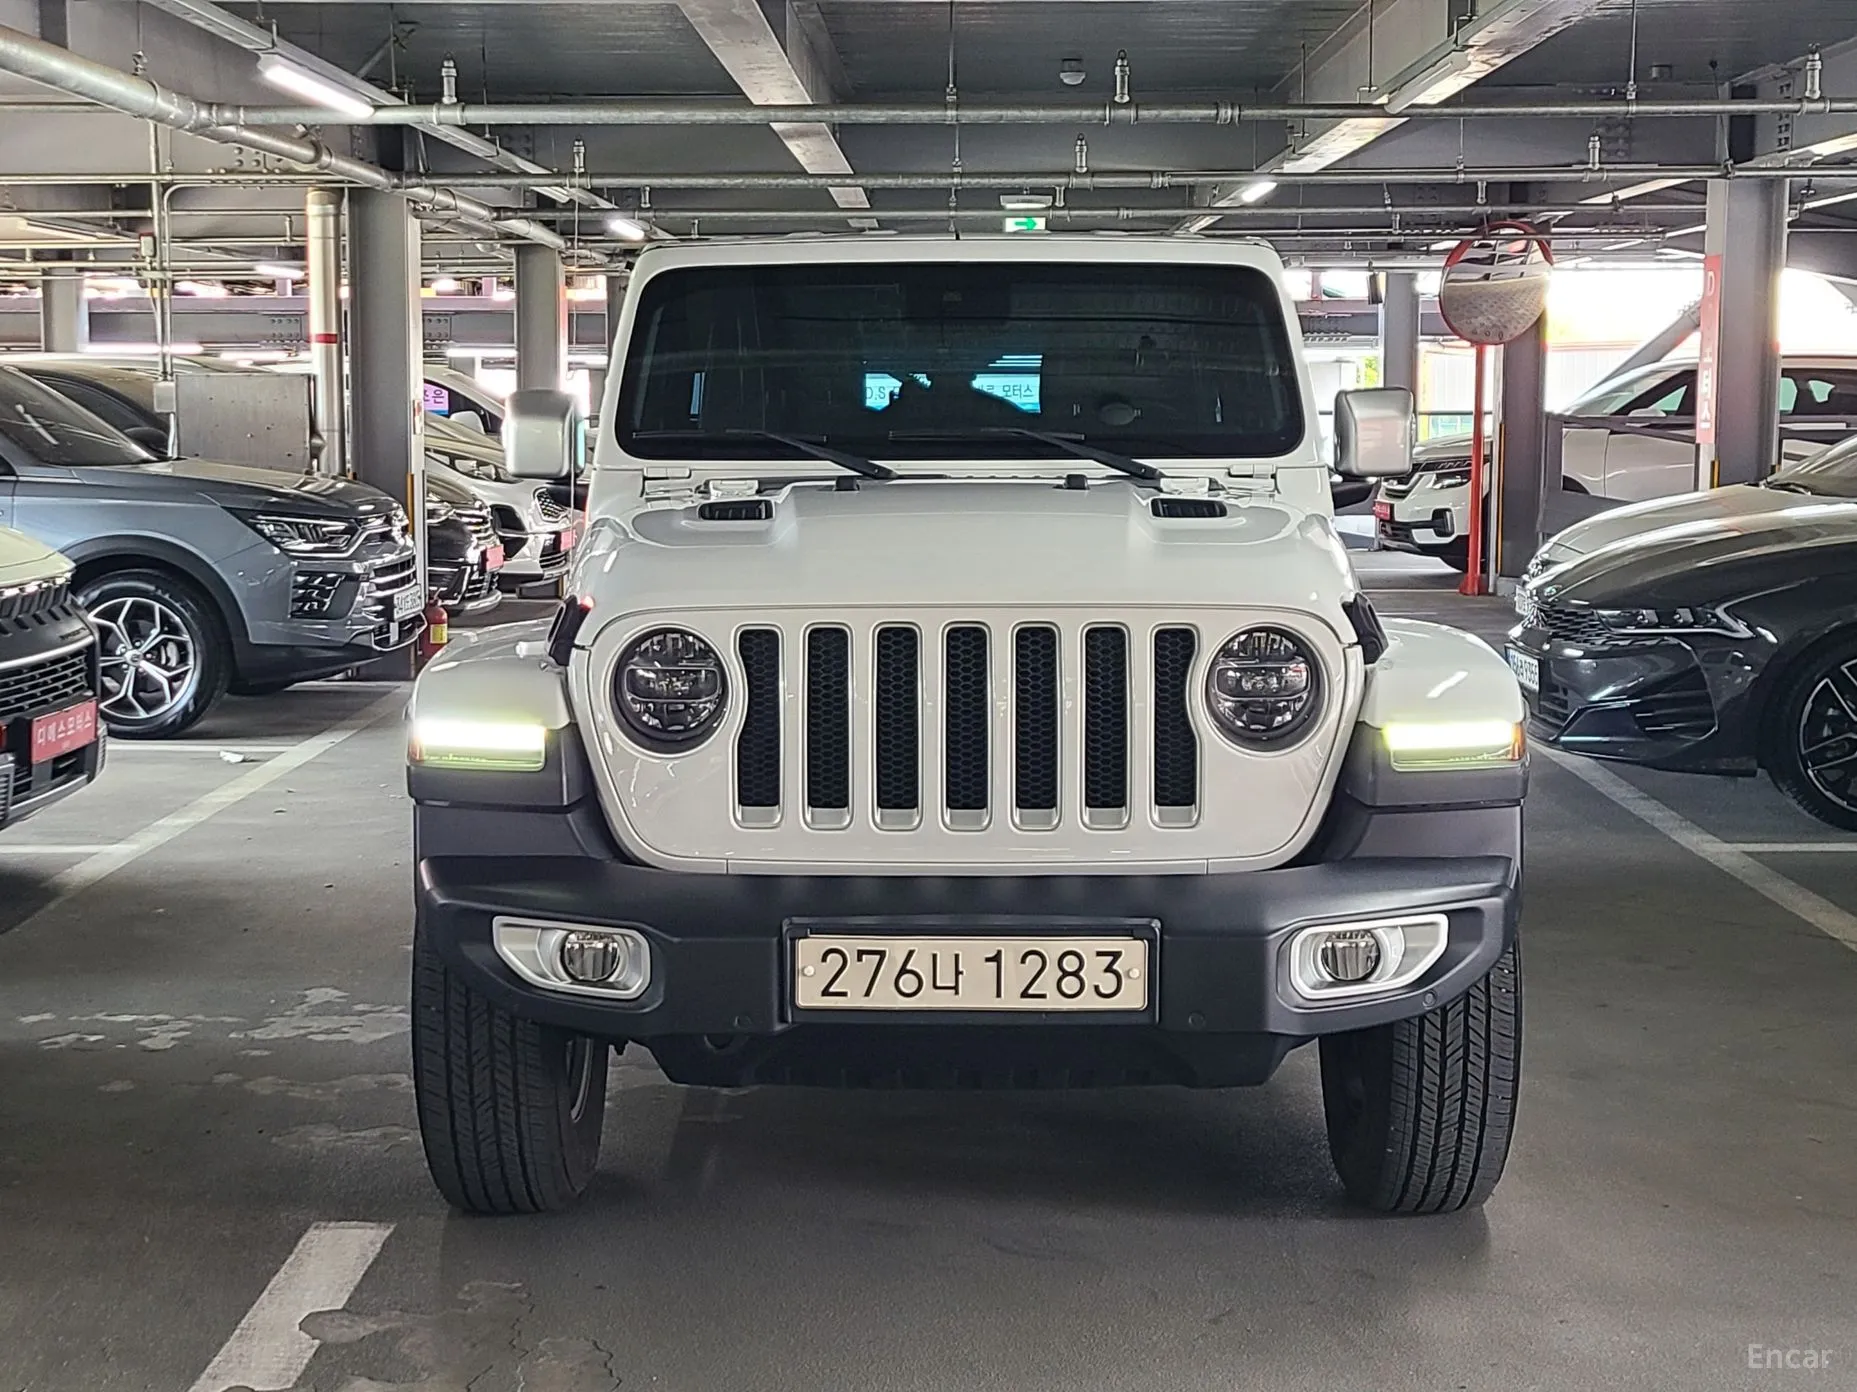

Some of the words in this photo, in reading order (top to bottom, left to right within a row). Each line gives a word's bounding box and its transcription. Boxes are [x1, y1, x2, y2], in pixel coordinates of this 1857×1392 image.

[1002, 384, 1035, 399] 모터스
[820, 947, 964, 999] 276나
[984, 948, 1124, 999] 1283
